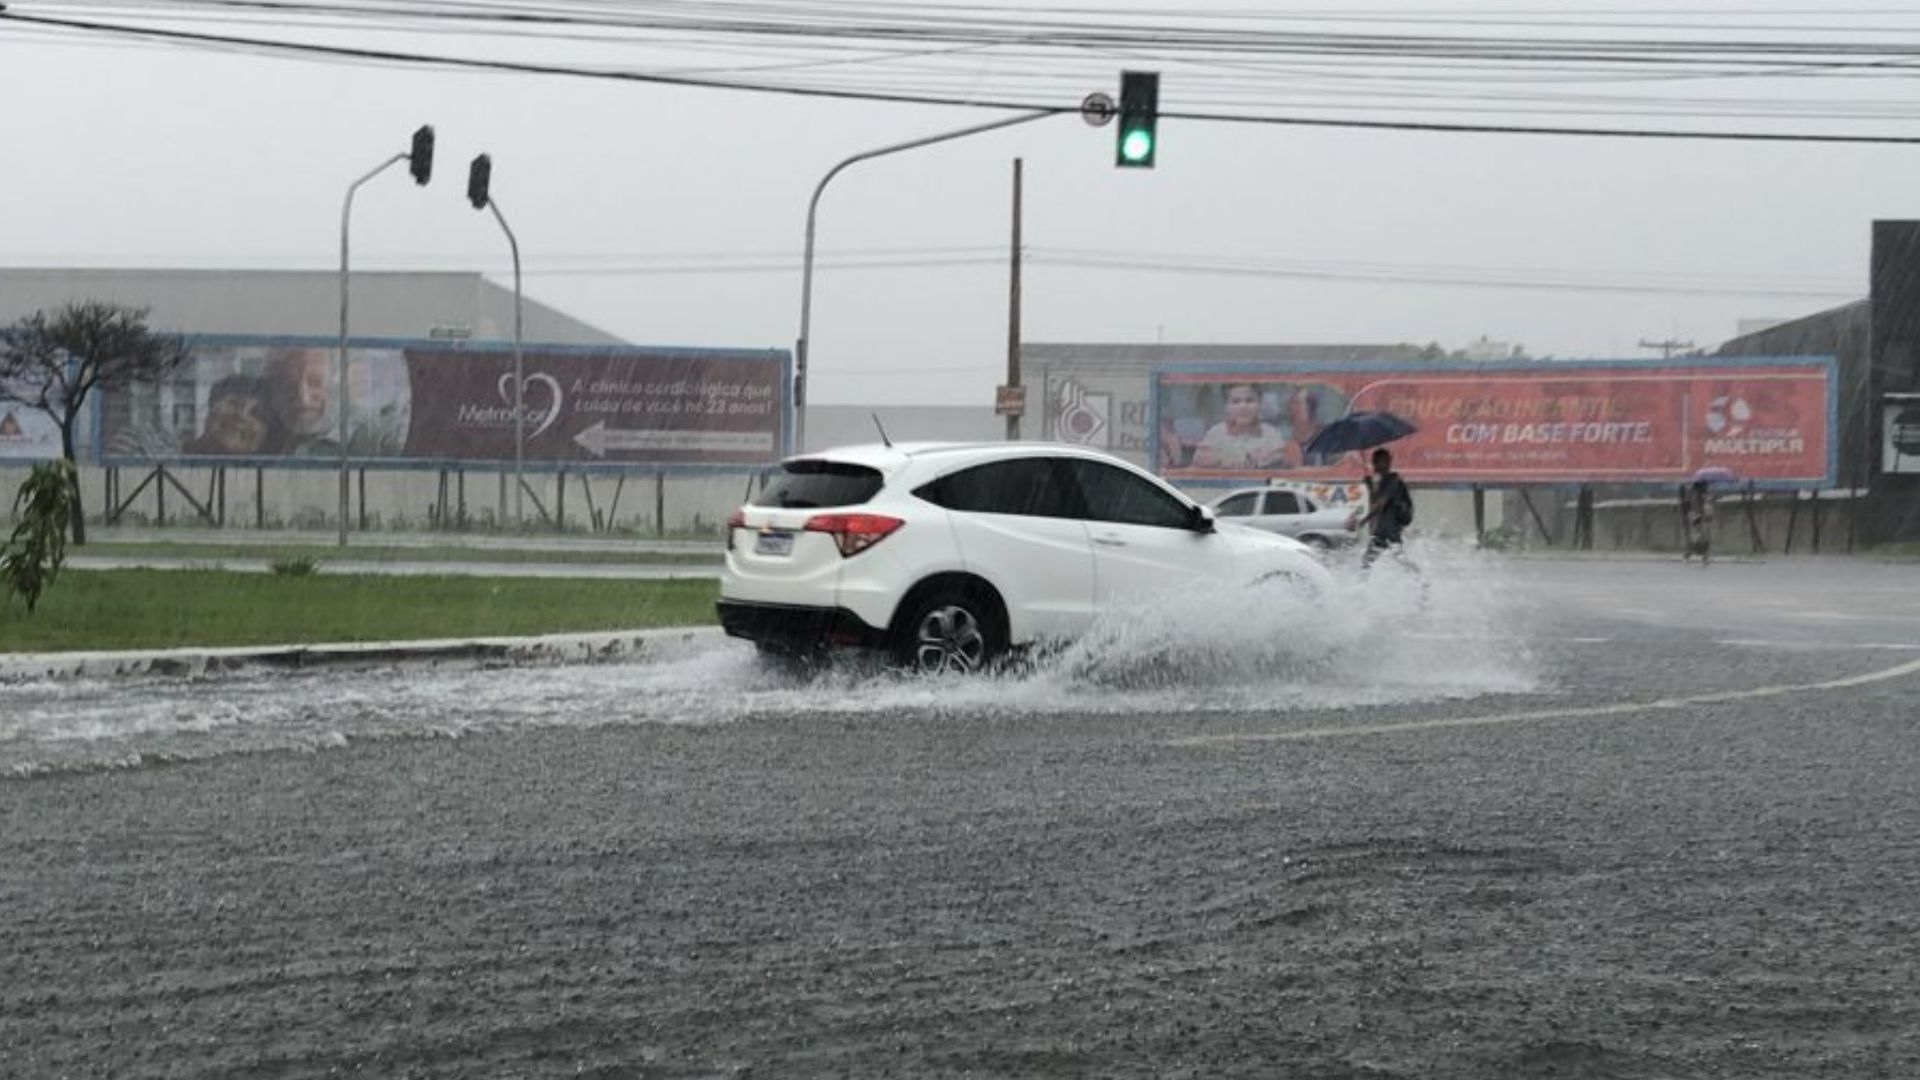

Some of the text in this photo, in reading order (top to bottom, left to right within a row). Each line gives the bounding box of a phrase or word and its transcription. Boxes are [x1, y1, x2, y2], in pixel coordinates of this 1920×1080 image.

[1446, 422, 1653, 443] COM BASE FORTE.
